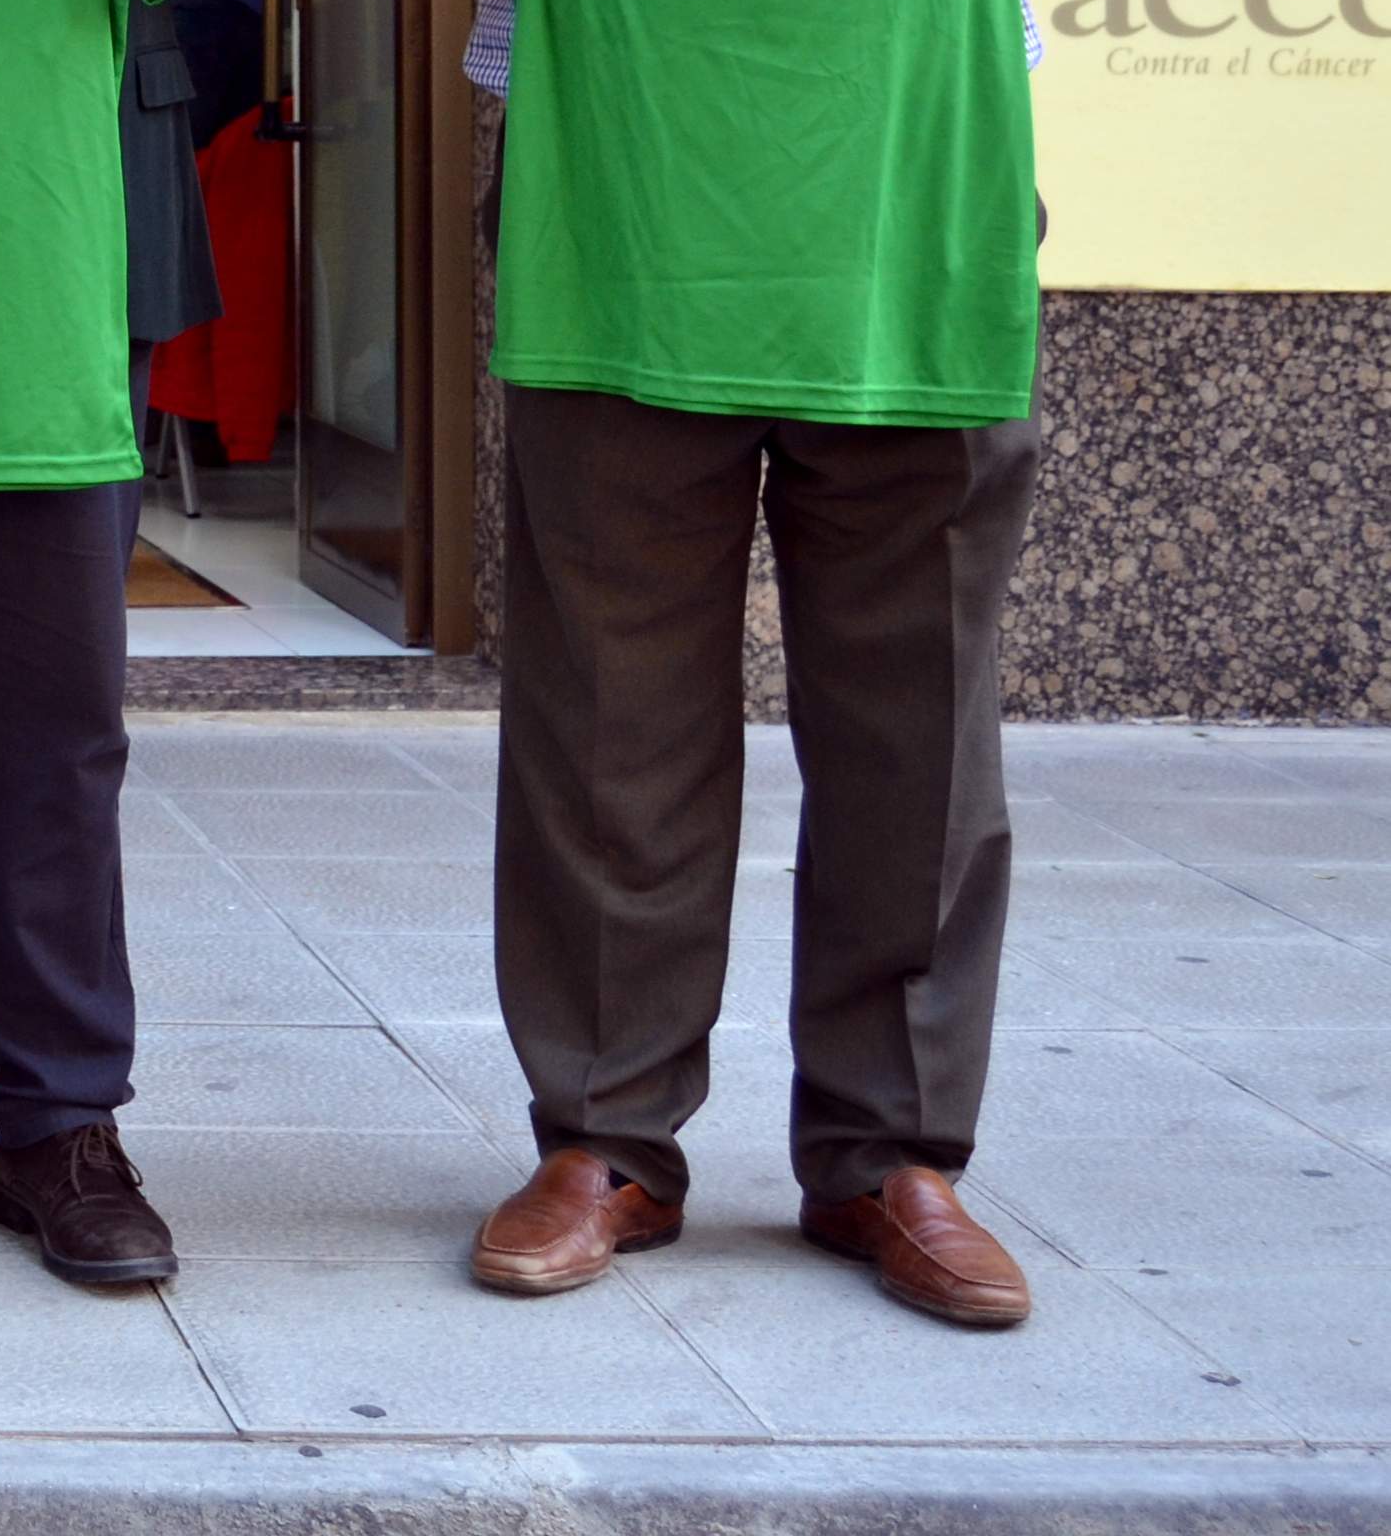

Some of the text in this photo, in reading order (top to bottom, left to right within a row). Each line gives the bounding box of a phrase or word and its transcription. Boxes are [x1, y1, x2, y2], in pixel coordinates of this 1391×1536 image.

[1106, 46, 1377, 77] Contra el Cáncer
